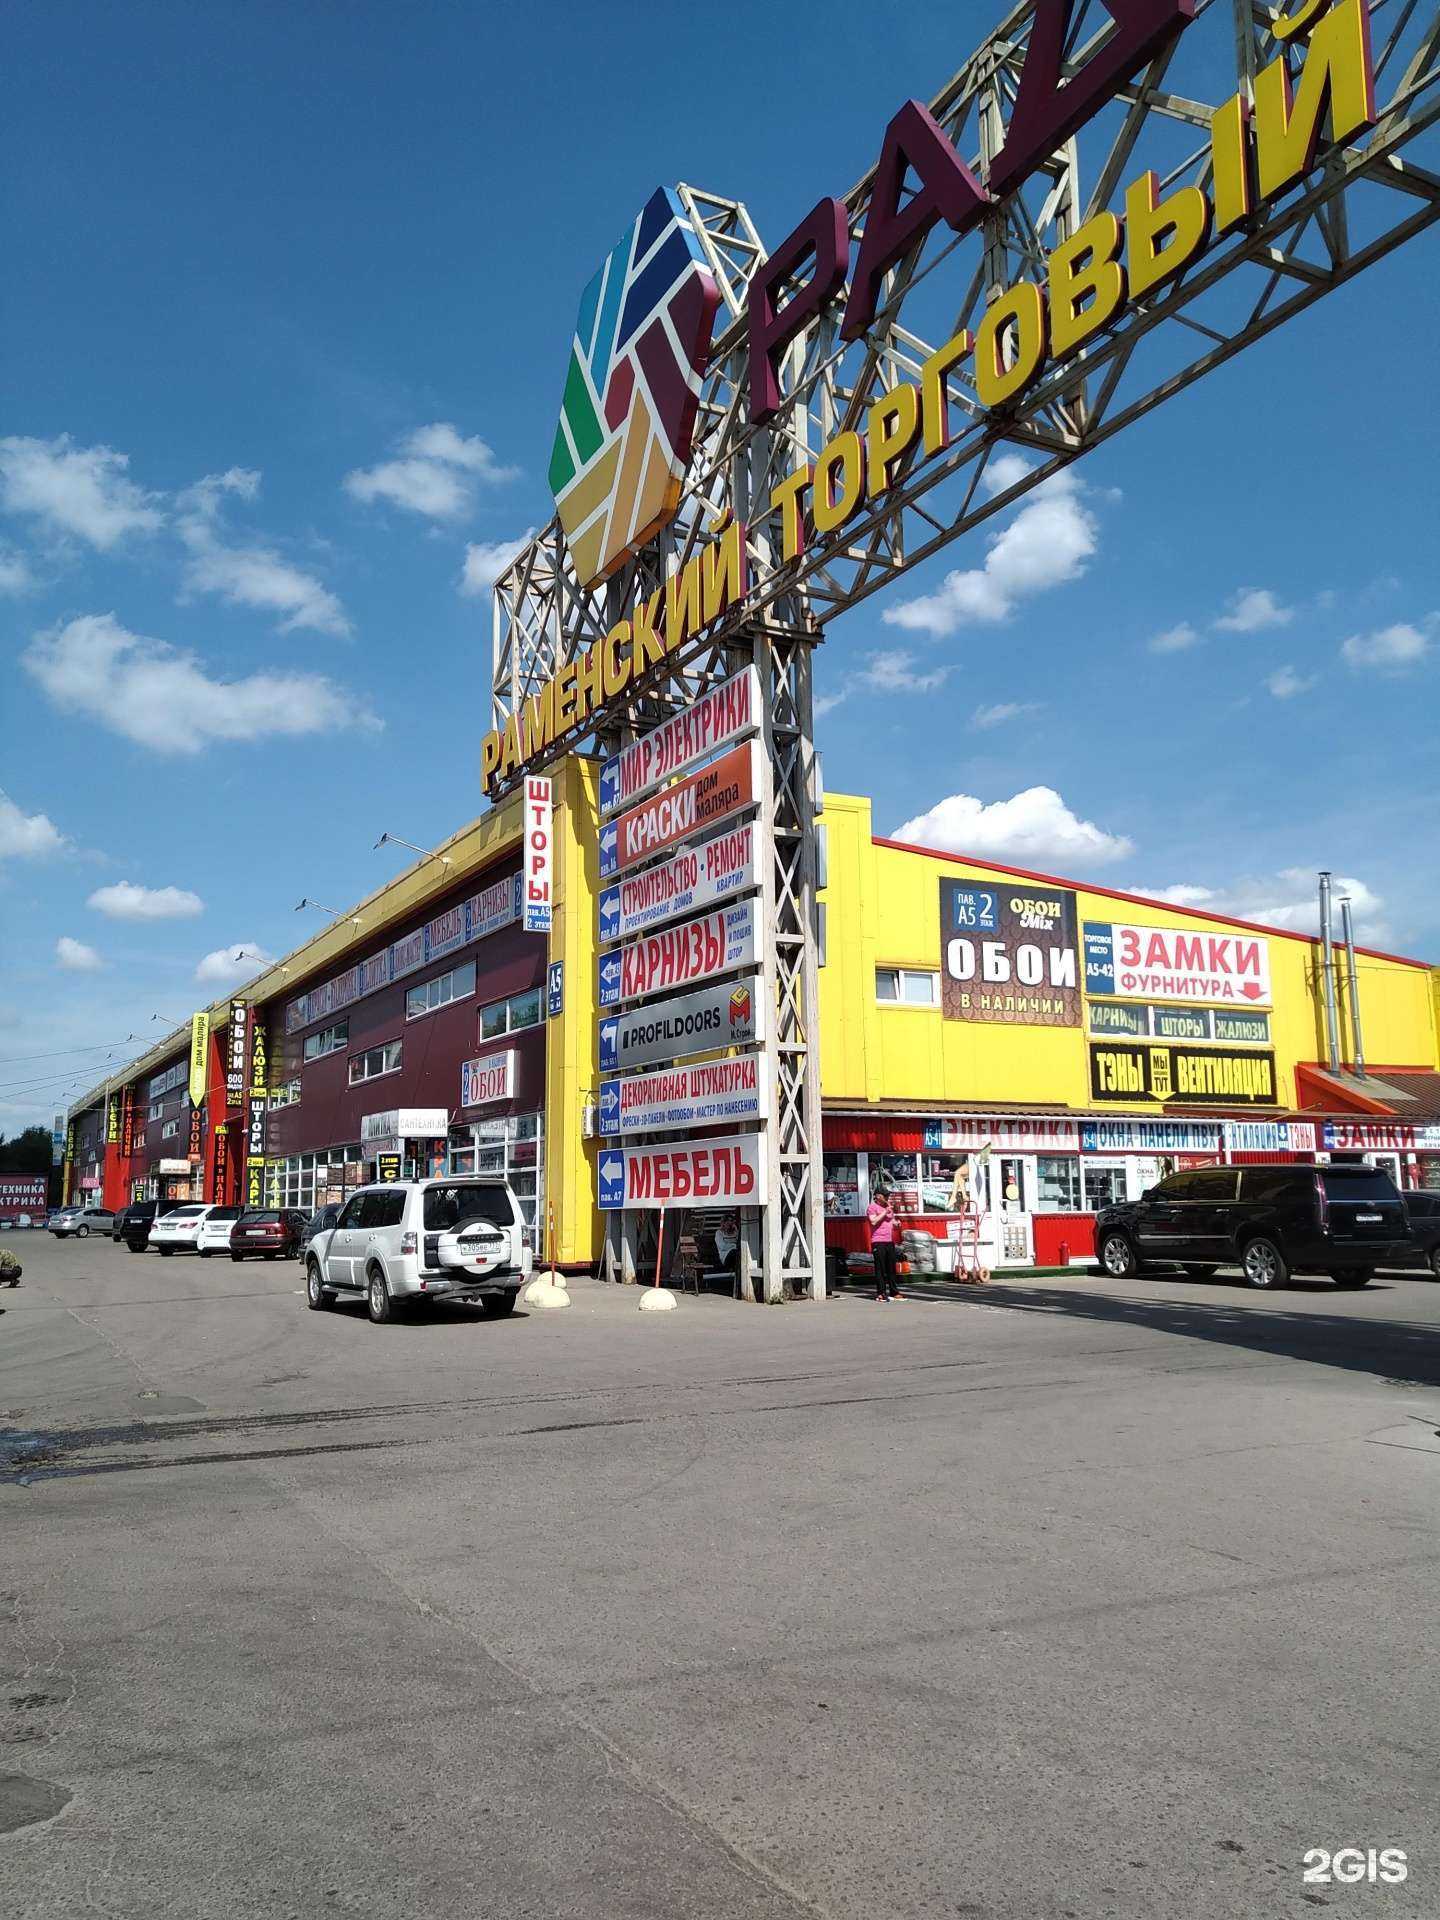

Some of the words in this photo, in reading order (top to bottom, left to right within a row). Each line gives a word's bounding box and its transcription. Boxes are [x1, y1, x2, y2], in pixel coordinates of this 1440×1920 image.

[480, 508, 746, 795] РАМЕНСКИЙ
[770, 0, 1378, 563] ТОРГОВЫЙ
[620, 740, 651, 800] МИР
[655, 672, 750, 777] ЭЛЕКТРИКИ
[696, 780, 741, 822] маляра
[626, 785, 698, 857] КРАСКИ
[528, 779, 549, 901] ШТОРЫ
[622, 852, 698, 917] СТРОИТЕЛЬСТВО
[707, 827, 751, 881] РЕМОНТ
[673, 891, 693, 912] ДОМОВ
[716, 871, 744, 893] КВАРТИР
[958, 894, 976, 905] ПАВ.
[979, 894, 993, 918] 2
[958, 906, 976, 925] А5
[1010, 898, 1061, 918] ОБОИ
[733, 925, 751, 942] ПОШИВ
[1020, 912, 1054, 931] Mix
[1085, 934, 1112, 944] ТОРГОВОЕ
[1090, 945, 1108, 955] МЕСТО
[621, 914, 726, 997] КАРНИЗЫ
[727, 908, 748, 929] ДИЗАЙН
[727, 947, 743, 960] ШТОР
[947, 938, 1076, 988] ОБОИ
[1120, 929, 1261, 976] ЗАМКИ
[550, 967, 561, 994] А5
[1087, 963, 1114, 978] А5-42
[1121, 972, 1234, 998] ФУРНИТУРА
[961, 994, 970, 1008] В
[981, 995, 1064, 1014] НАЛИЧИИ
[630, 1006, 720, 1048] PROFILDOORS
[1089, 1006, 1137, 1032] КАРНИЫ
[1161, 1017, 1204, 1037] ШТОРЫ
[1216, 1019, 1266, 1040] ЖАЛЮЗИ
[233, 1008, 245, 1069] ОБОИ
[253, 1026, 266, 1086] ЖАЛЮЗИ
[227, 1073, 243, 1083] 600
[471, 1066, 506, 1102] ОБОИ
[621, 1072, 687, 1112] ДЕКОРАТИВНАЯ
[690, 1060, 756, 1098] ШТУКАТУРКА
[1096, 1053, 1145, 1092] ТЭНЫ
[1153, 1055, 1168, 1069] МЫ
[1177, 1056, 1272, 1101] ВЕНТИЛЯЦИЯ
[1154, 1077, 1168, 1091] ТУТ
[250, 1101, 263, 1153] ШТОРЫ
[622, 1115, 640, 1128] ФРЕСКИ
[696, 1104, 716, 1118] МАСТЕР
[717, 1103, 724, 1114] ПО
[190, 1110, 201, 1153] ОБОИ
[945, 1119, 1074, 1147] ЭЛЕКТРИКА
[1100, 1122, 1134, 1147] ОКНА
[1139, 1123, 1188, 1148] ПАНЕЛИ
[1192, 1123, 1217, 1148] ПВХ
[1228, 1124, 1277, 1149] НТИЛЯЦИЯ
[1289, 1125, 1313, 1149] ТЭНЫ
[1336, 1124, 1415, 1147] ЗАМКИ
[629, 1147, 754, 1200] МЕБЕЛЬ
[613, 1191, 622, 1200] А7
